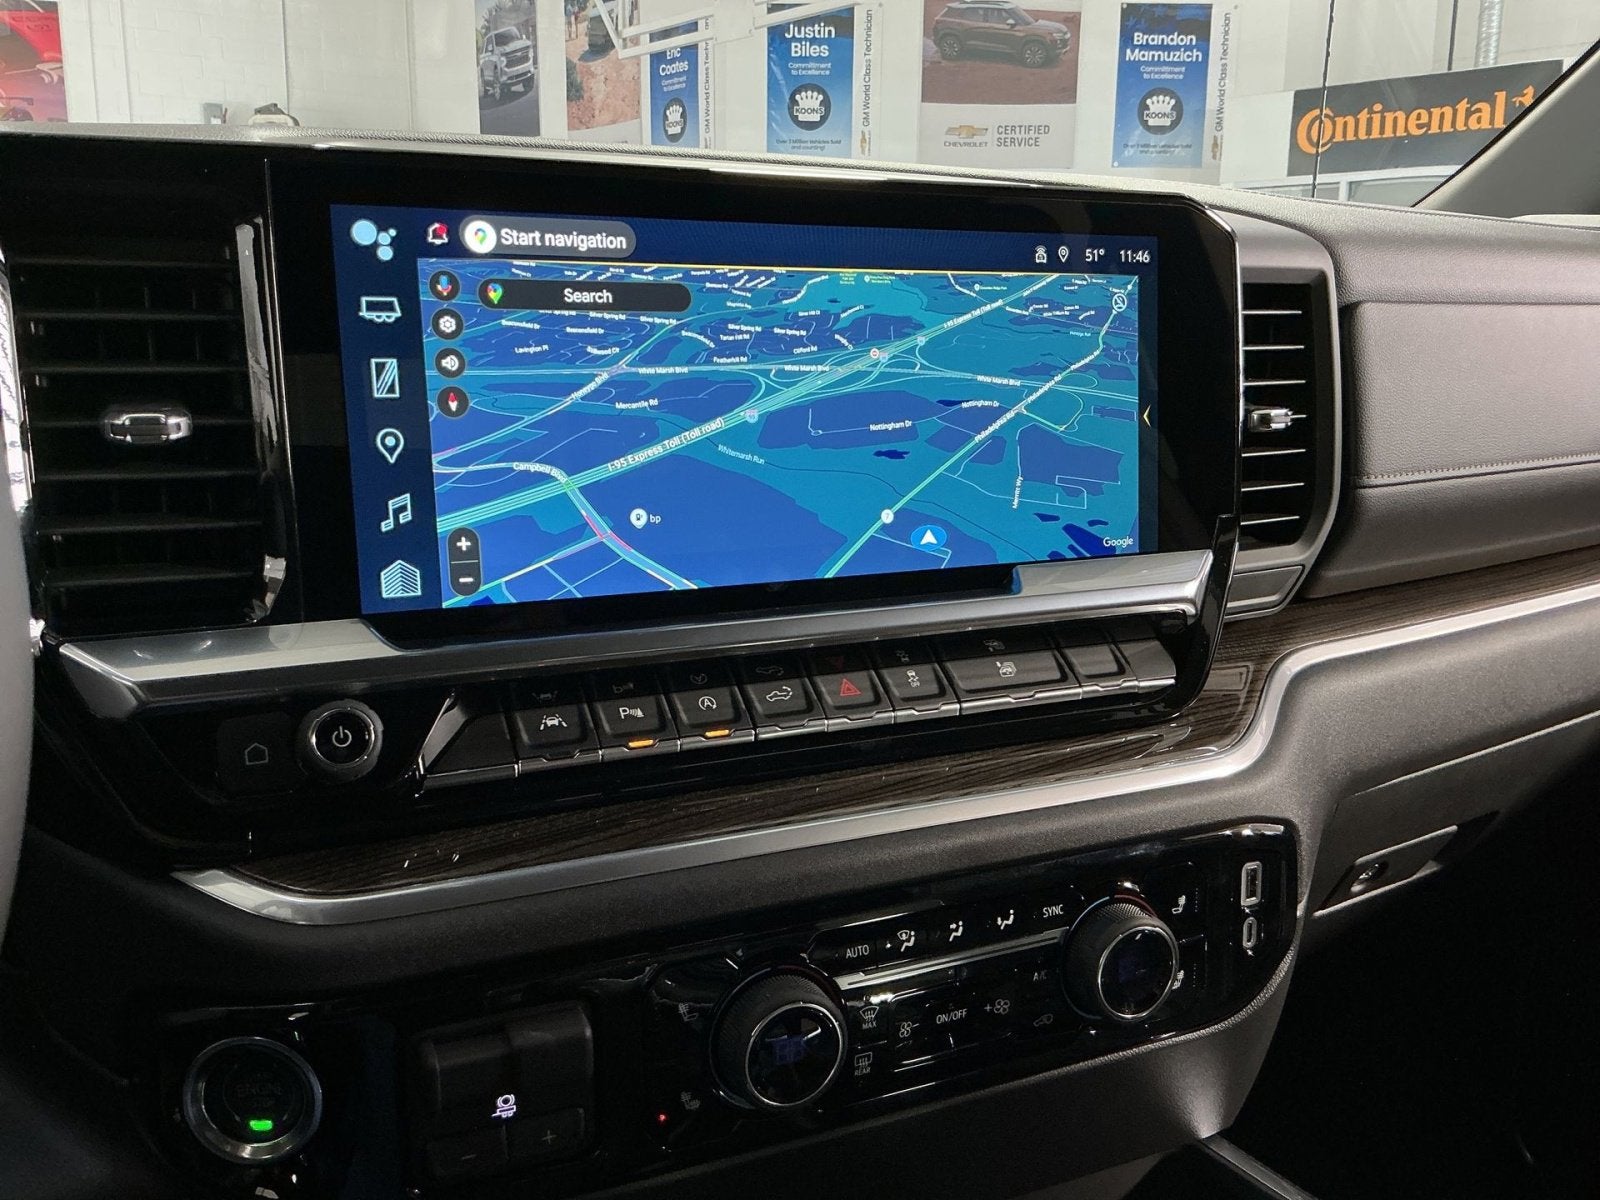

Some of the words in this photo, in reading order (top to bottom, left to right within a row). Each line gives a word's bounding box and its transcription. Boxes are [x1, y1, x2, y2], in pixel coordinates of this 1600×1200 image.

[785, 22, 836, 39] Justin
[864, 9, 873, 57] Technician
[1220, 12, 1231, 61] Technician
[1133, 32, 1196, 46] Brandon
[791, 41, 830, 58] Biles
[1125, 48, 1202, 62] Mamuzich
[659, 60, 689, 76] Coates
[1218, 62, 1227, 88] Class
[863, 83, 871, 110] World
[1217, 88, 1225, 113] World
[795, 107, 824, 115] KOONS
[1145, 111, 1176, 120] KOONS
[863, 111, 872, 127] GM
[1296, 91, 1507, 155] Continental
[996, 125, 1050, 135] CERTIFIED
[996, 137, 1040, 147] SERVICE
[501, 228, 541, 246] Start
[544, 231, 627, 251] navigation
[1119, 249, 1151, 263] 11:46
[563, 288, 613, 303] Search
[616, 400, 648, 409] Mercantile
[648, 398, 659, 406] Rd
[962, 400, 993, 408] Nottingham
[869, 421, 902, 431] Nottingham
[903, 420, 912, 428] Dr
[607, 457, 628, 472] I-95
[627, 445, 664, 467] Express
[665, 436, 681, 450] Toll
[681, 427, 701, 445] (Toll
[700, 417, 725, 437] road)
[718, 444, 752, 461] Whitemarsh
[752, 454, 765, 465] Run
[513, 462, 551, 475] Campbell
[550, 467, 567, 483] Blvd
[650, 514, 661, 524] bp
[1103, 536, 1134, 548] Google
[1042, 904, 1064, 919] SYNC
[846, 945, 870, 959] AUTO
[936, 1008, 968, 1025] ON/OFF
[862, 1020, 877, 1029] MAX
[854, 1067, 871, 1076] REAR
